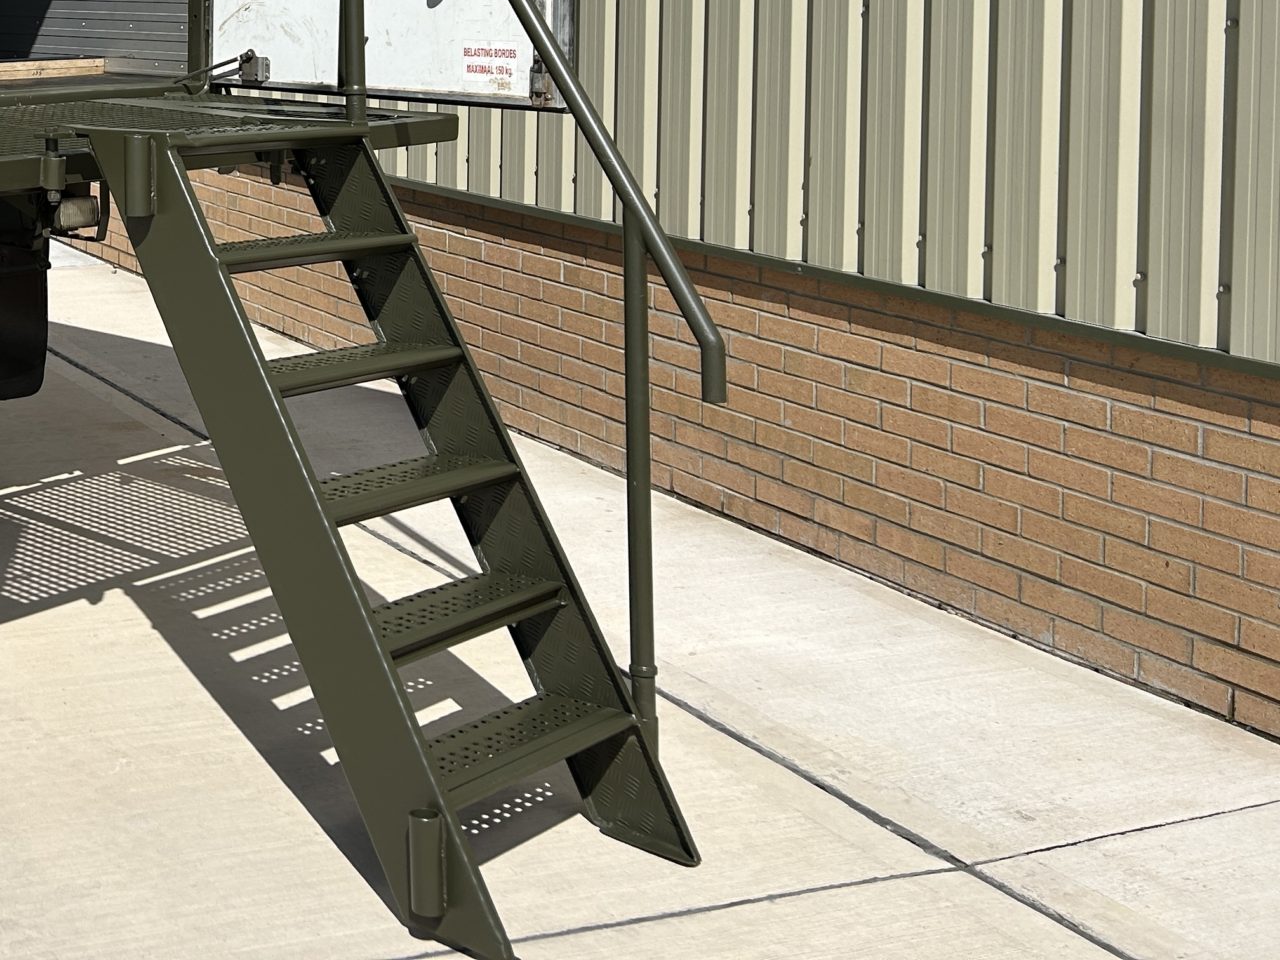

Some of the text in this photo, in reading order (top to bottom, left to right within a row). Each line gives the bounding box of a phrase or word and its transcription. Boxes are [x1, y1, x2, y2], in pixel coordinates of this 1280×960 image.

[463, 47, 517, 59] BELASTING BORDES
[466, 64, 494, 76] MAXIMAAL
